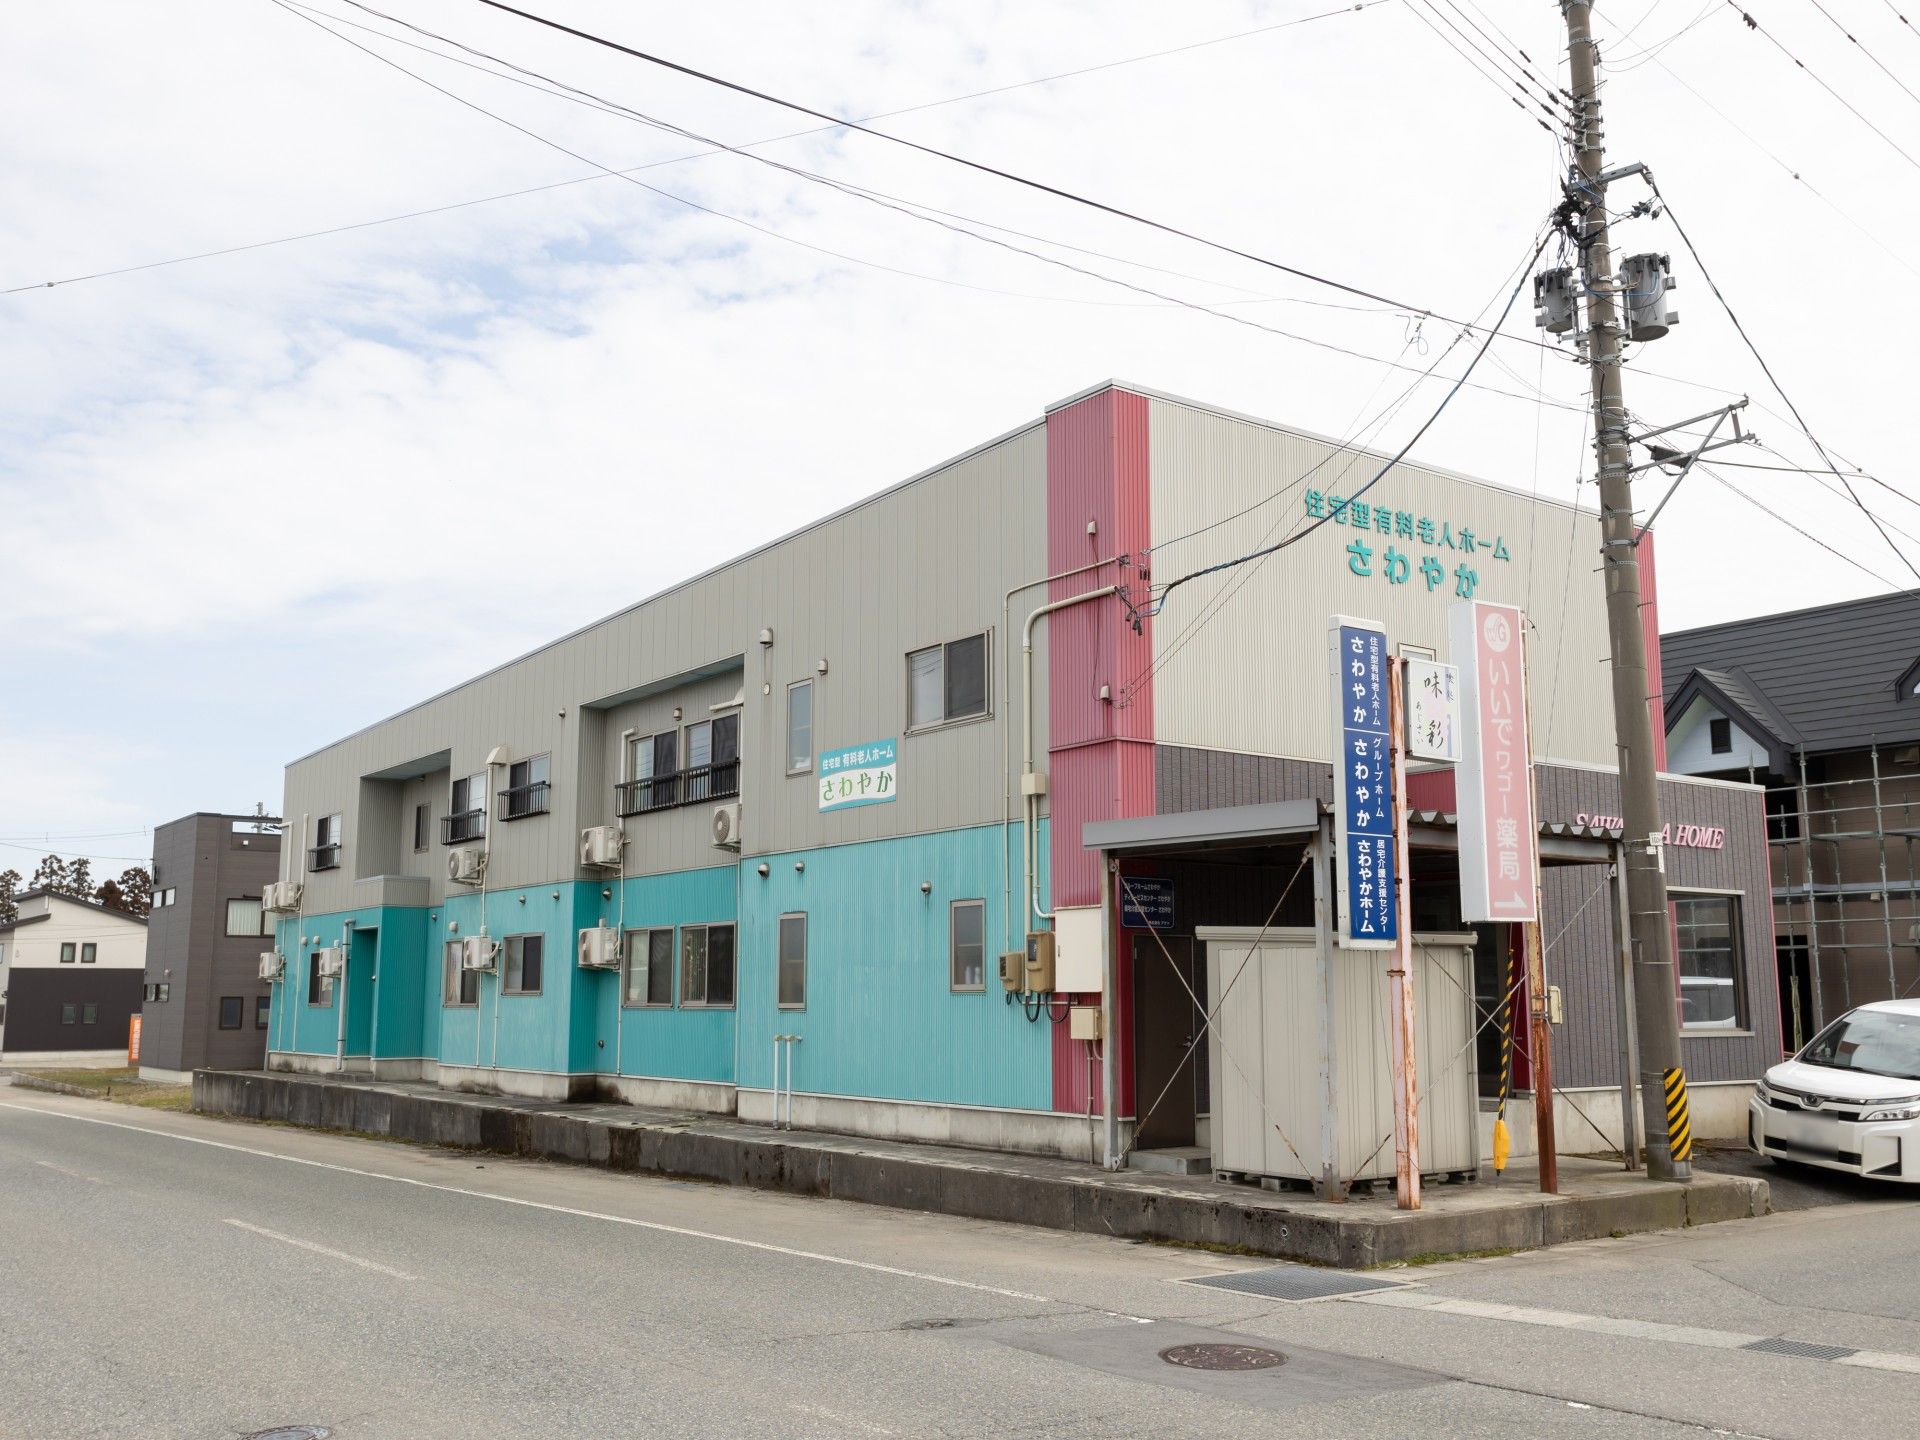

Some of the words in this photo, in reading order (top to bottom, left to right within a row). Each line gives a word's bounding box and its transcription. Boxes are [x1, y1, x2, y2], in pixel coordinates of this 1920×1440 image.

[1305, 486, 1512, 562] 住宅型有料老人ホーム
[1346, 538, 1479, 598] さわやか
[1350, 636, 1367, 723] さわやか
[1370, 636, 1381, 726] 住宅型有料老人ホーム
[1423, 671, 1444, 750] 味彩
[821, 770, 893, 801] さわやか
[843, 745, 894, 768] 有料老人ホーム
[1354, 738, 1371, 827] さわやか
[1373, 737, 1385, 818] グループホーム
[1489, 658, 1521, 881] いいでワゴー薬局
[1673, 824, 1725, 849] HOME
[1357, 839, 1375, 933] さわやかホーム
[1376, 839, 1388, 933] 居宅介護支援センター
